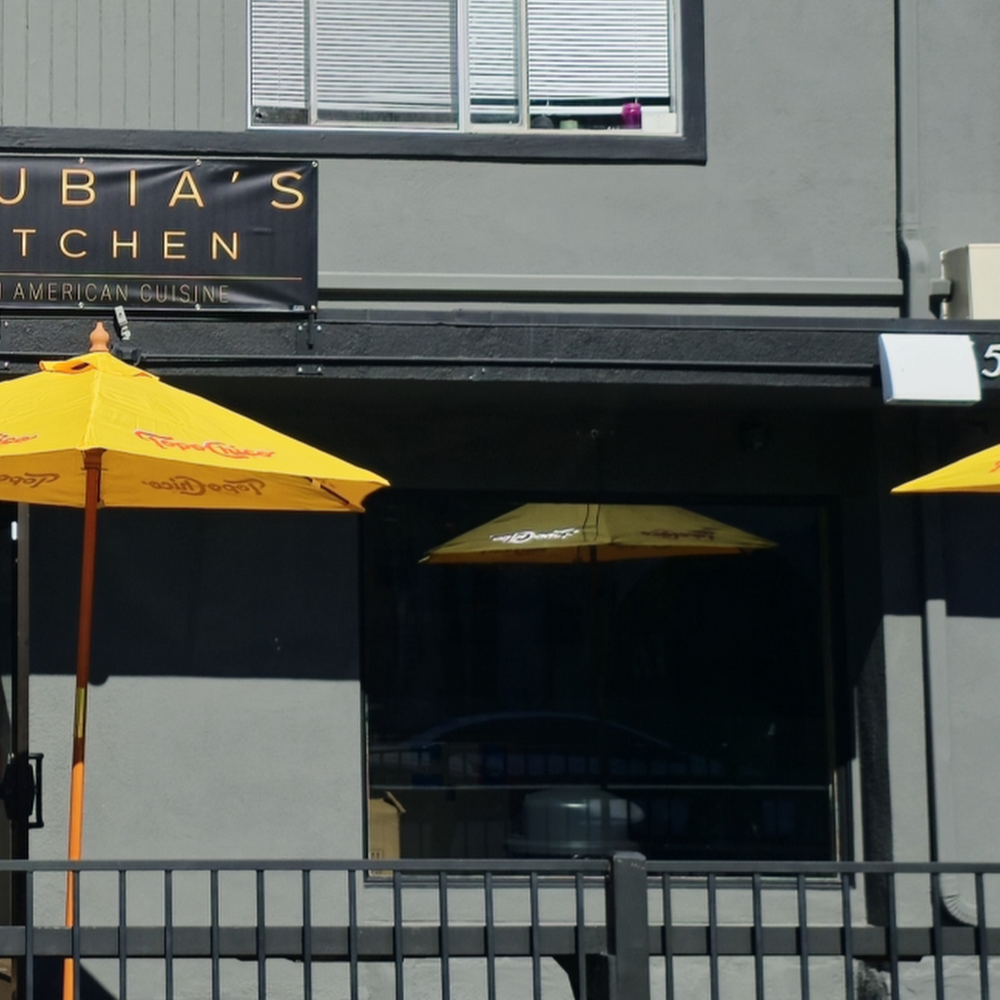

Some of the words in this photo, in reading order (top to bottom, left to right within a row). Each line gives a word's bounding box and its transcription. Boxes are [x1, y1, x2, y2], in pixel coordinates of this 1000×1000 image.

[13, 282, 129, 302] AMERICAN
[140, 284, 229, 304] CUISINE
[134, 429, 205, 450] Topo
[204, 441, 275, 460] Chico
